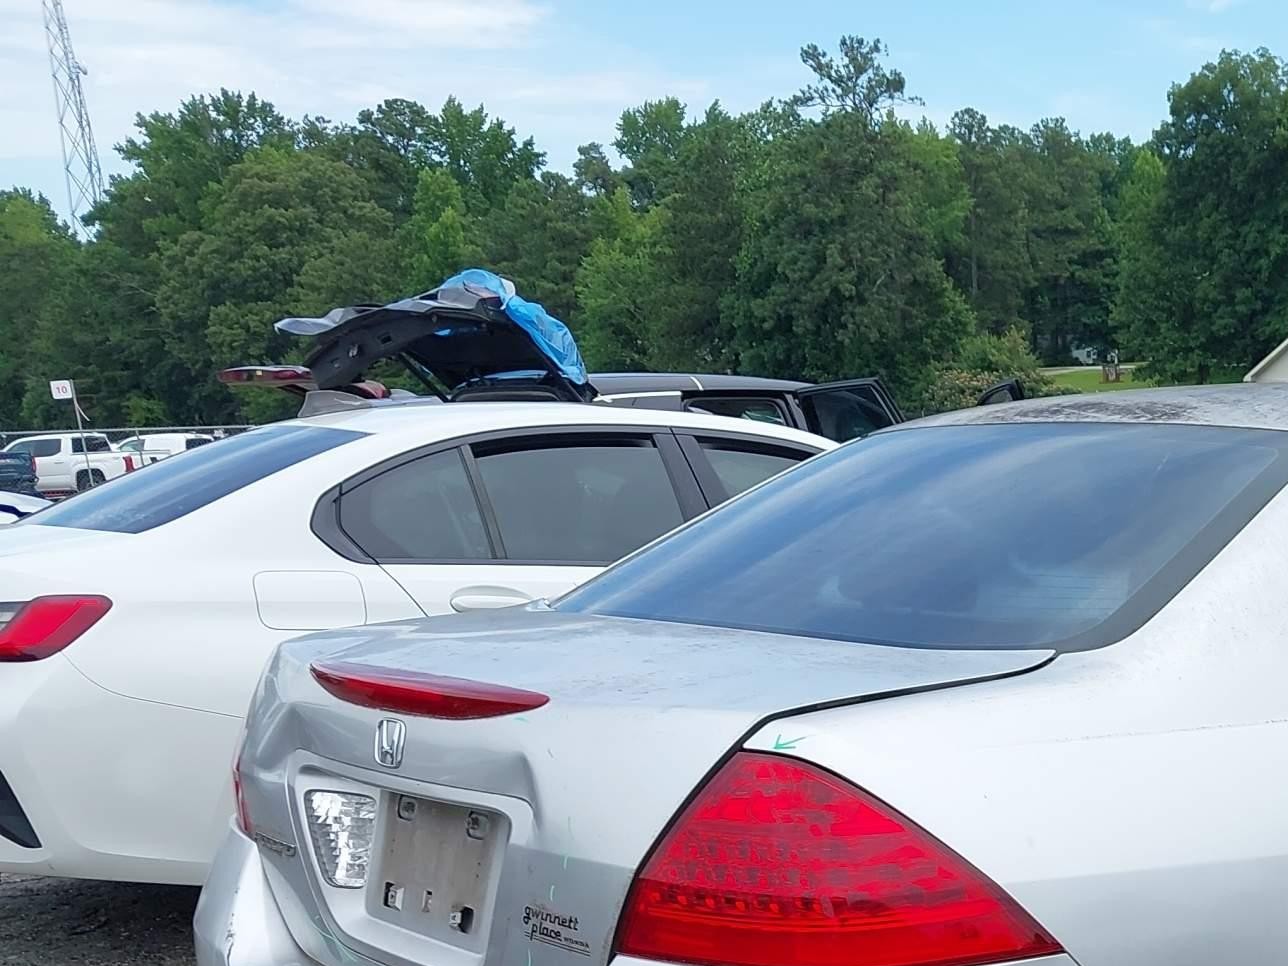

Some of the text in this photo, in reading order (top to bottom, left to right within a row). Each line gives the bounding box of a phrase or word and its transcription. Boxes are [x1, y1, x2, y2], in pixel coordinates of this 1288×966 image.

[56, 385, 68, 394] 10
[523, 905, 579, 931] gwinnett
[529, 921, 563, 941] place
